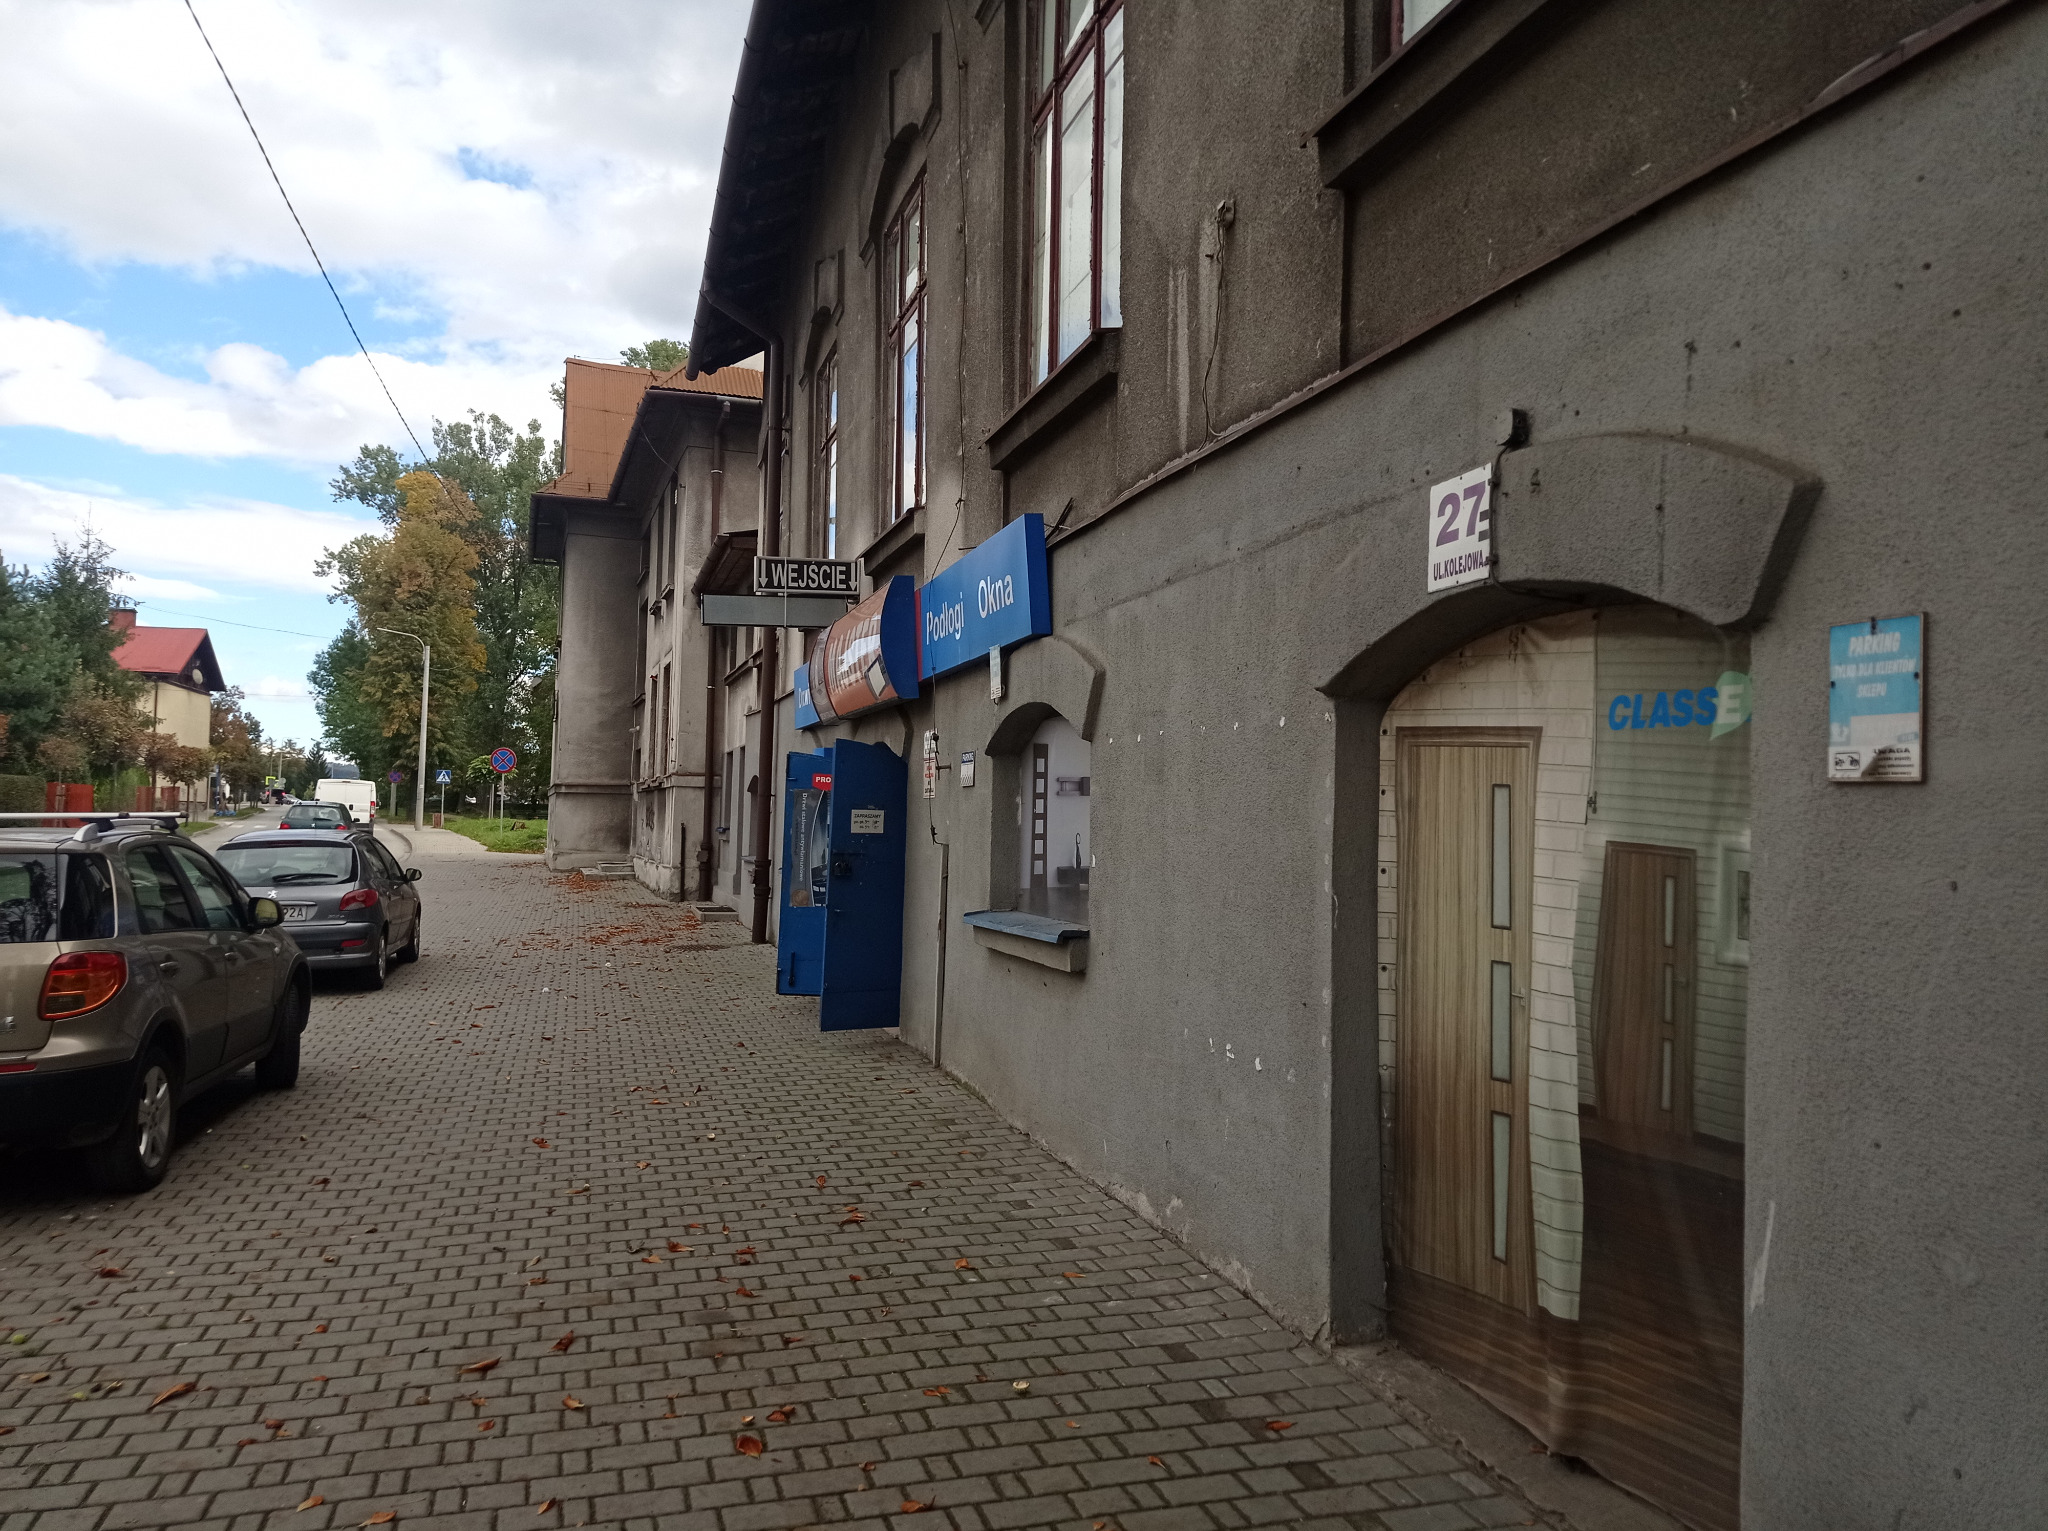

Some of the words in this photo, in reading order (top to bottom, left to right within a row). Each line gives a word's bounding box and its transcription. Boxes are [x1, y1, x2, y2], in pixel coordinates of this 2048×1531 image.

[1436, 481, 1486, 547] 27
[771, 561, 847, 589] WEJŚCIE
[926, 591, 965, 646] Podłogi
[978, 574, 1014, 619] Okna
[1848, 631, 1901, 658] PARKING
[1608, 684, 1752, 731] CLASSE
